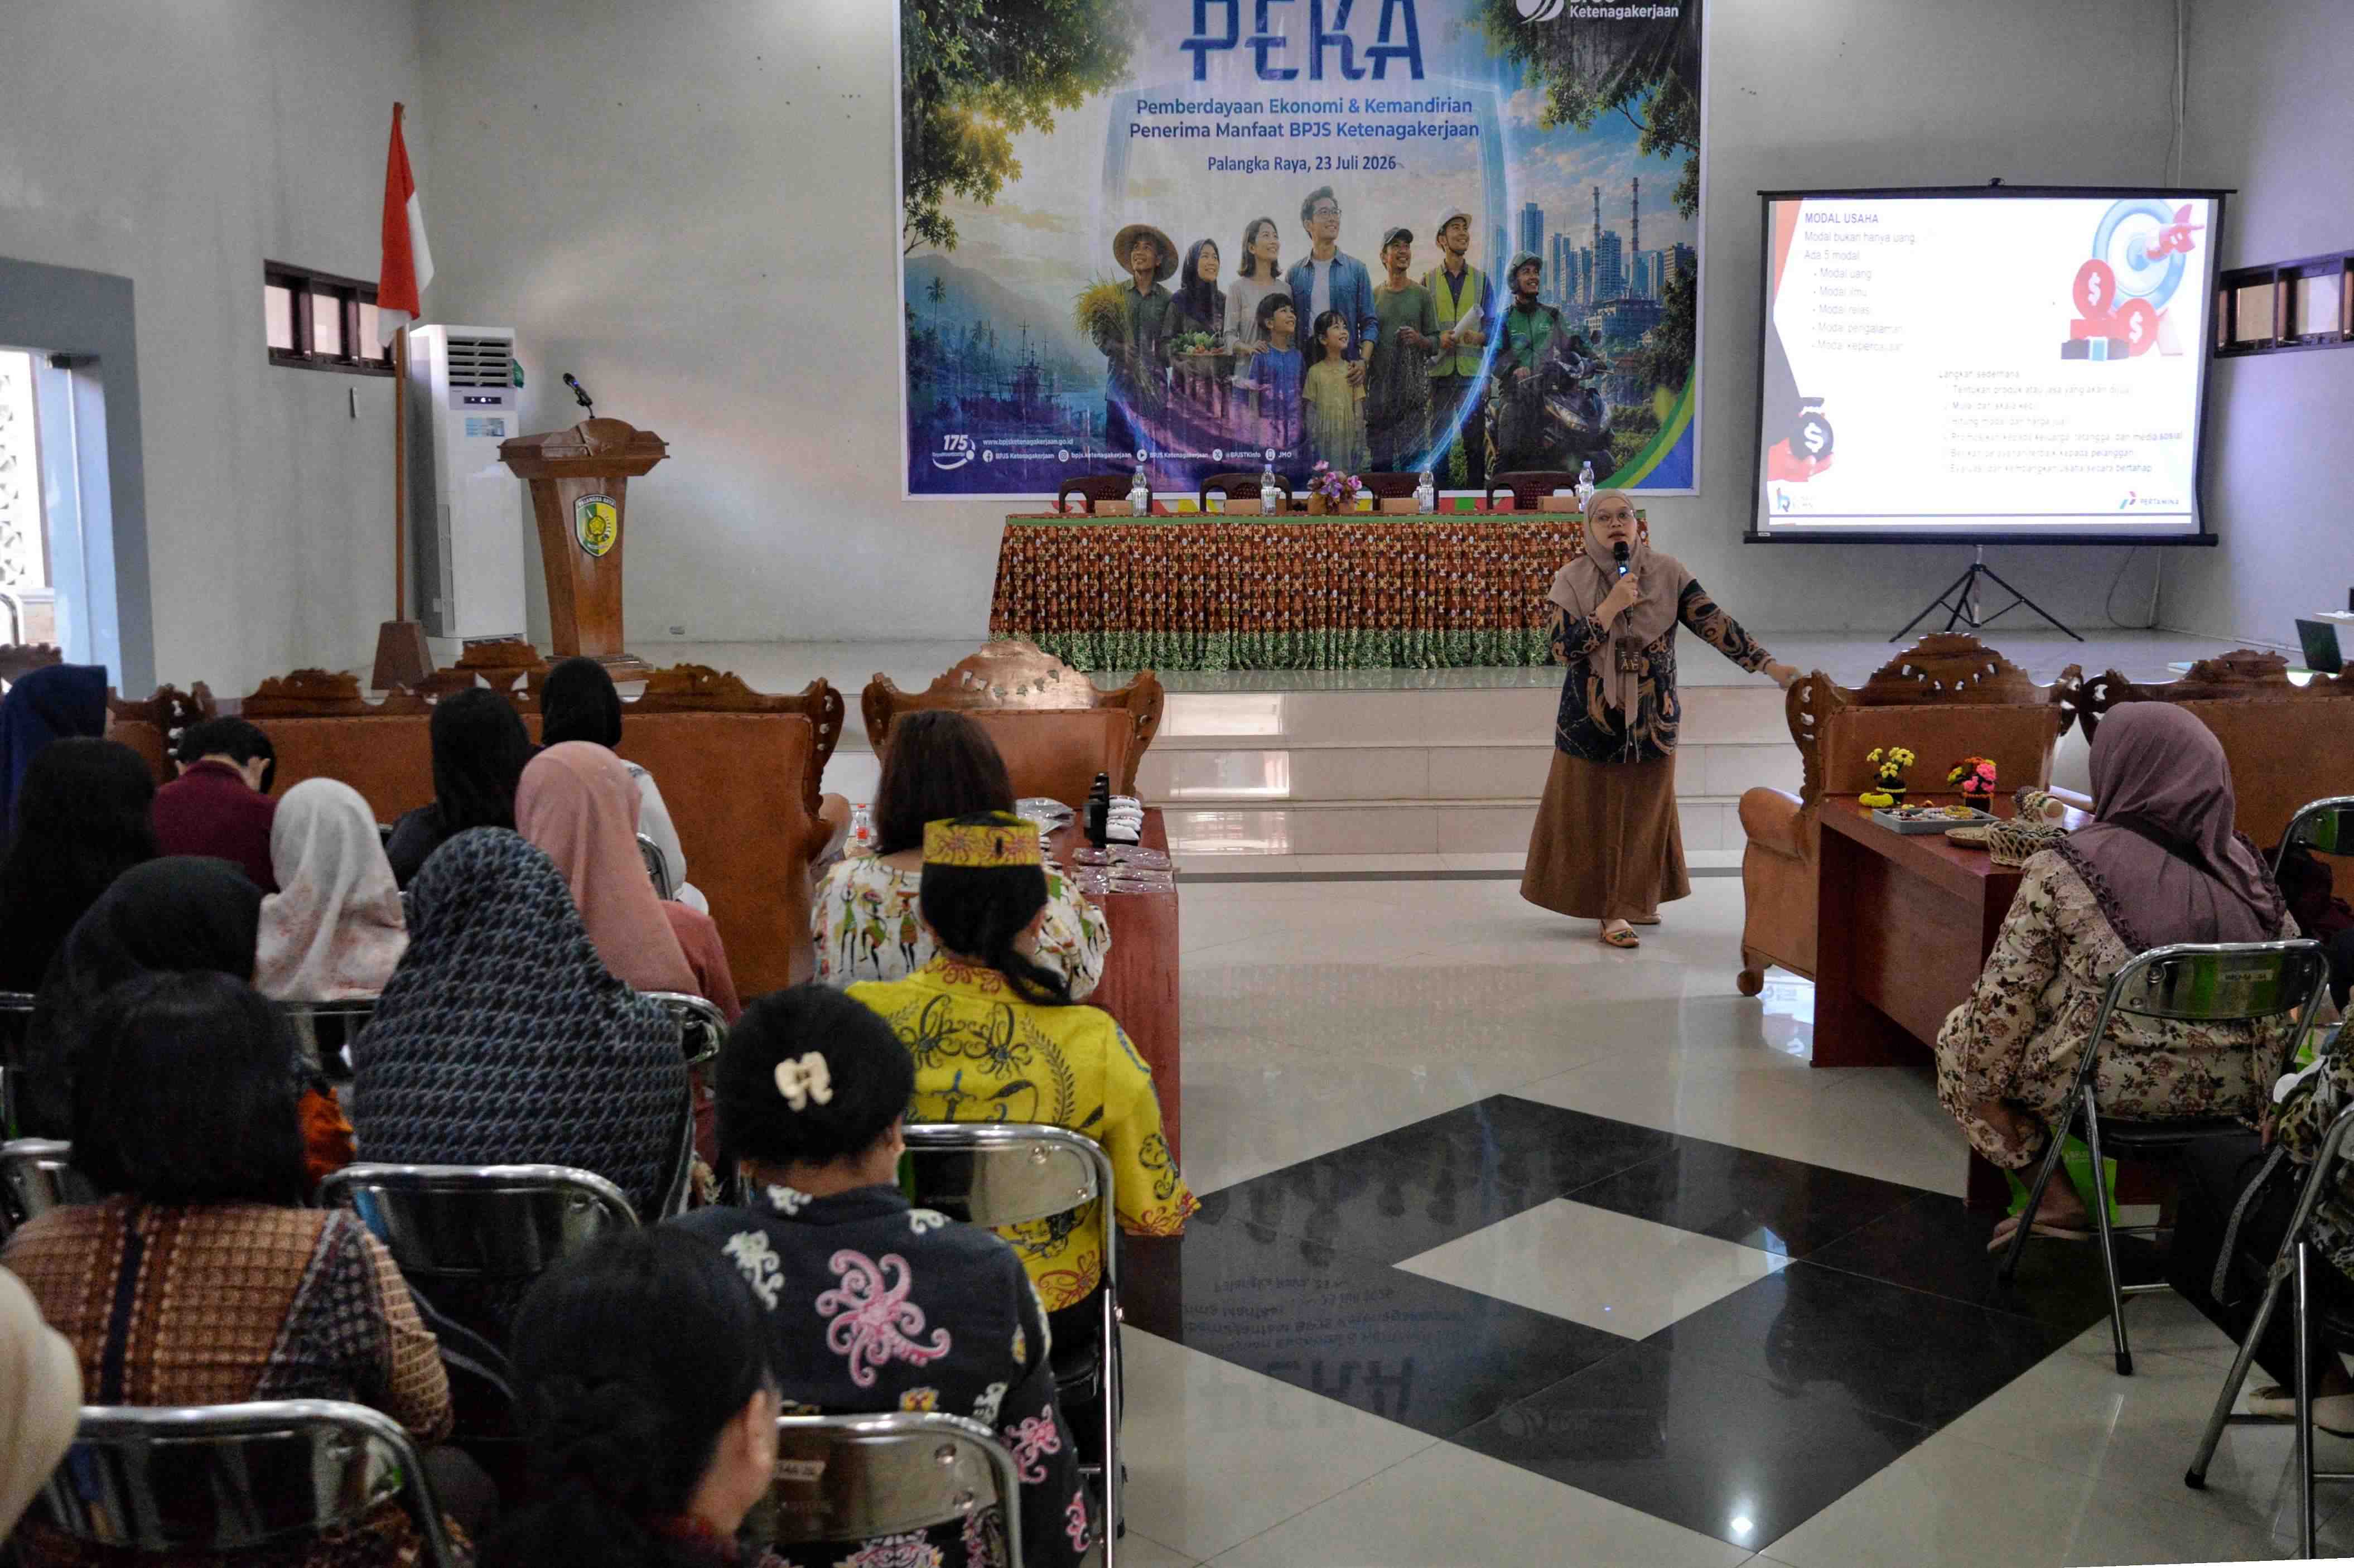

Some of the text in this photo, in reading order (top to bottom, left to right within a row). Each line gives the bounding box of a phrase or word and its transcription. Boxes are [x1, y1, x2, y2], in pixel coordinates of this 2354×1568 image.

[1570, 4, 1679, 20] Ketenagakerjaan
[1179, 0, 1425, 81] PEKA
[1137, 97, 1473, 117] Pemberdayaan Ekonomi & Kemandirian
[1130, 119, 1479, 140] Penerima Manfaat BPJS Ketenagakerjaan
[1208, 156, 1396, 173] Palangka Raya, 23 Juli 2026
[1804, 213, 1879, 224] MODAL USAHA
[1804, 231, 1831, 242] Modal
[1834, 232, 1861, 242] bukan
[1863, 232, 1890, 245] hanya
[1803, 250, 1860, 260] Ada 5 modal
[1820, 268, 1847, 278] Modal
[943, 434, 969, 451] 175
